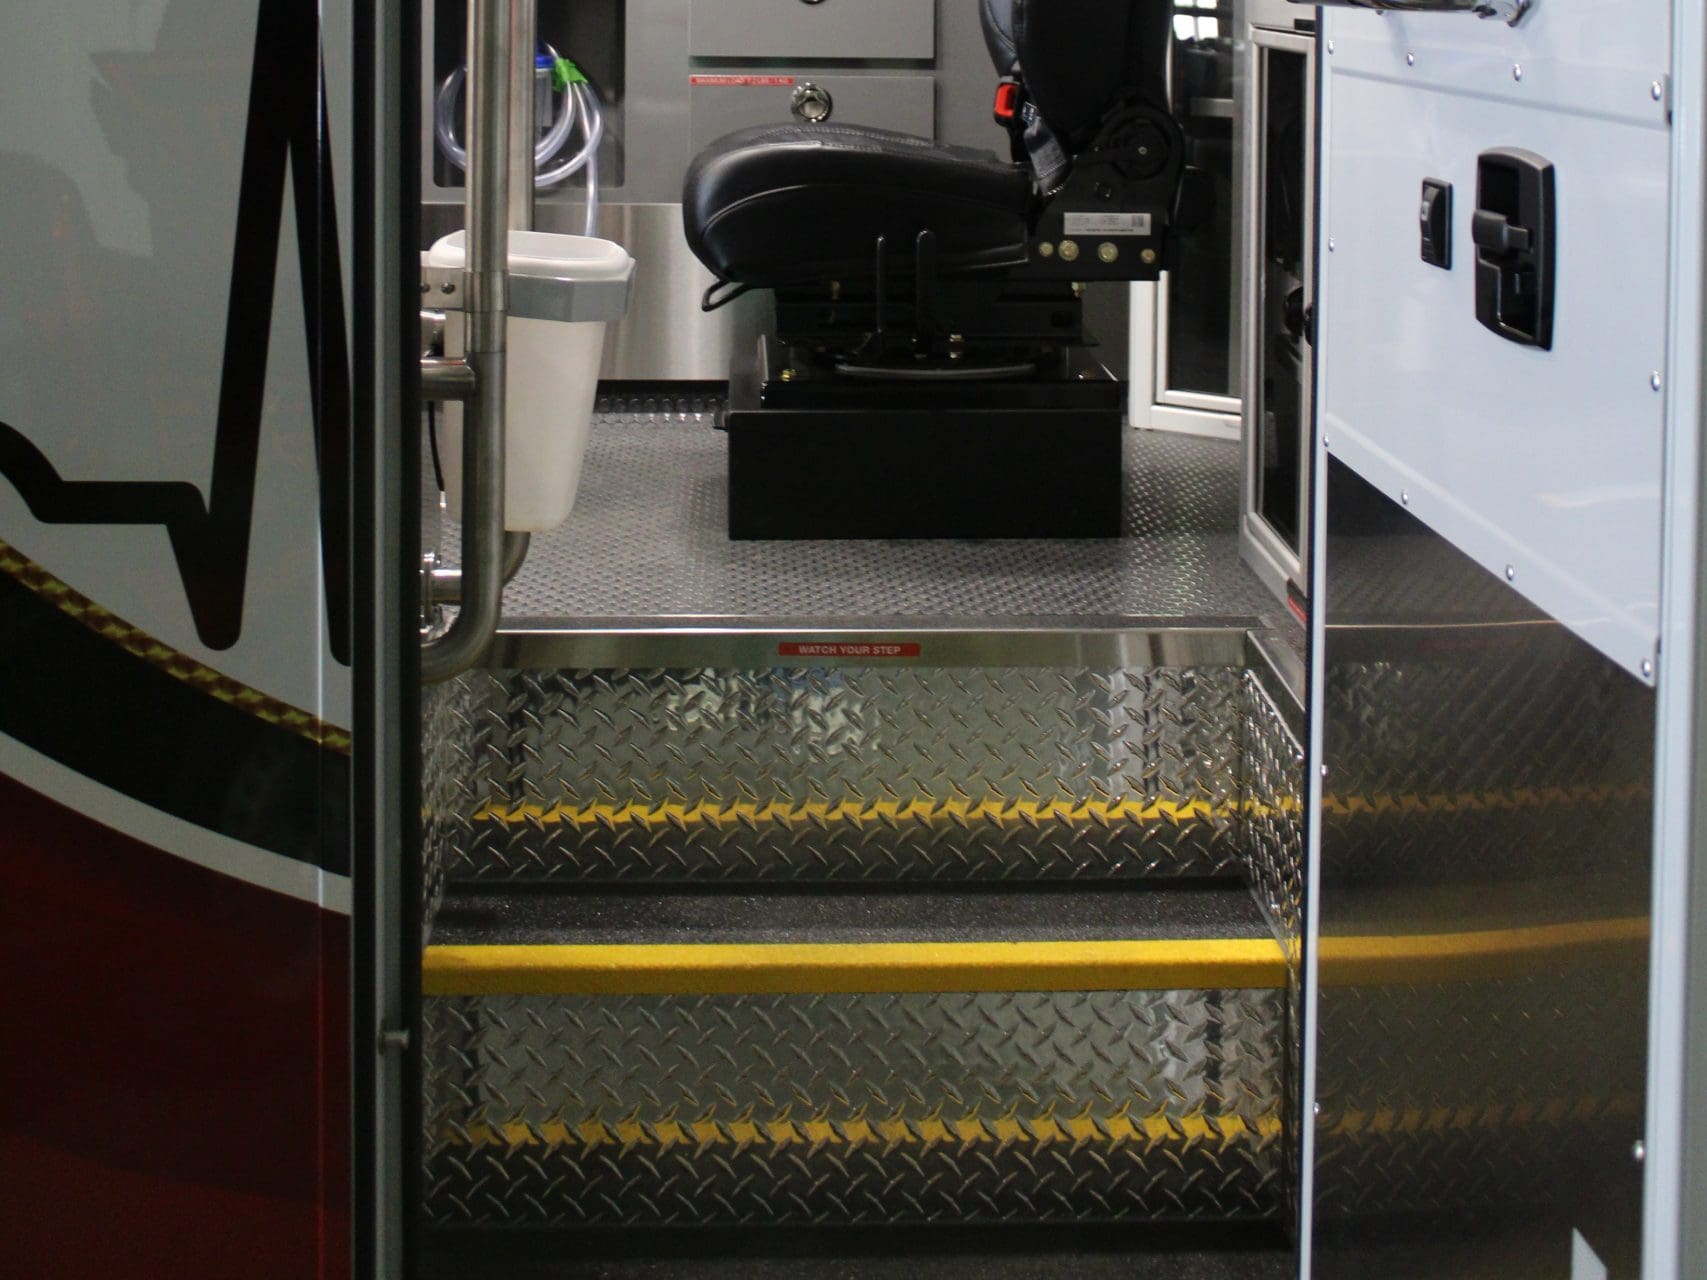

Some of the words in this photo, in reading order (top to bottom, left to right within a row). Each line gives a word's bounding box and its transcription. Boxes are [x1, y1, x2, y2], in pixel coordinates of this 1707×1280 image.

[799, 645, 837, 655] WATCH
[840, 645, 870, 655] YOUR
[873, 645, 902, 655] STEP
